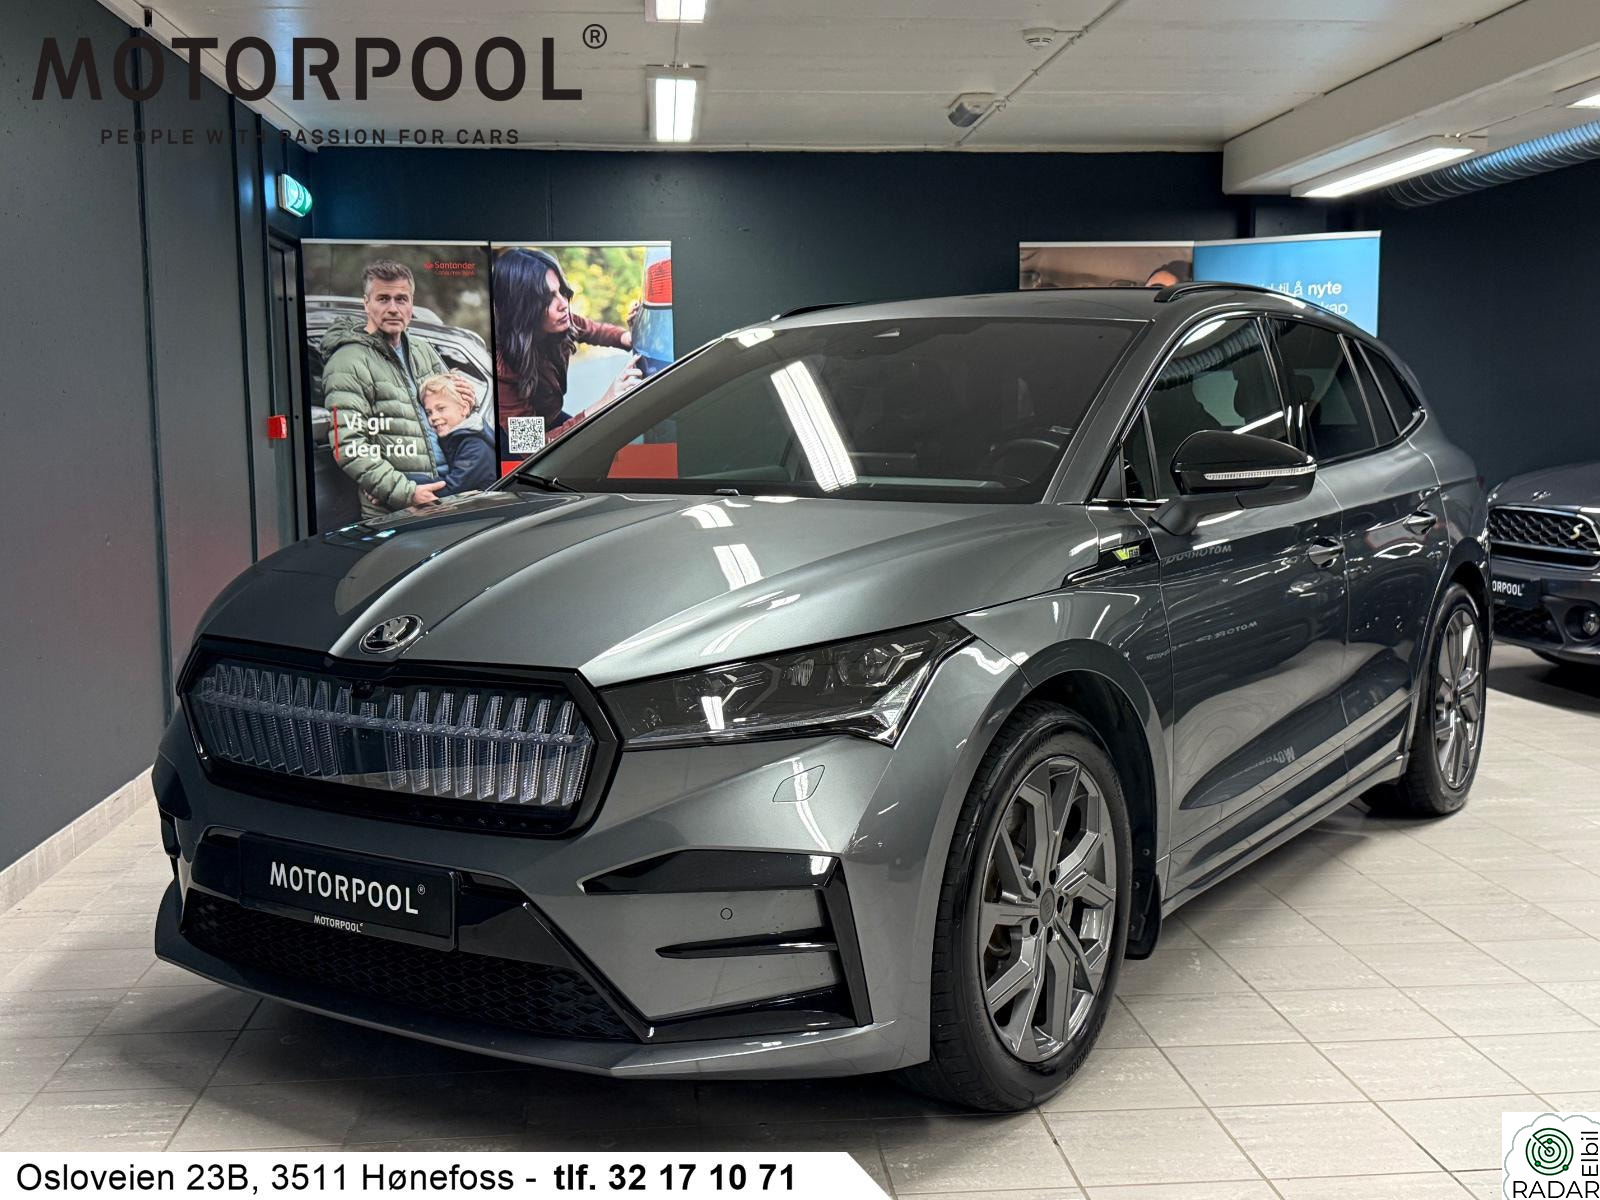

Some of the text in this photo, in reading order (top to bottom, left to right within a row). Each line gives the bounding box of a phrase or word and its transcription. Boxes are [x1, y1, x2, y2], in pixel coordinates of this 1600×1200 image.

[434, 260, 476, 269] Santander
[1308, 281, 1342, 298] nyte
[1319, 301, 1348, 314] kap
[343, 412, 393, 435] Vi gir
[344, 438, 417, 462] deg råd
